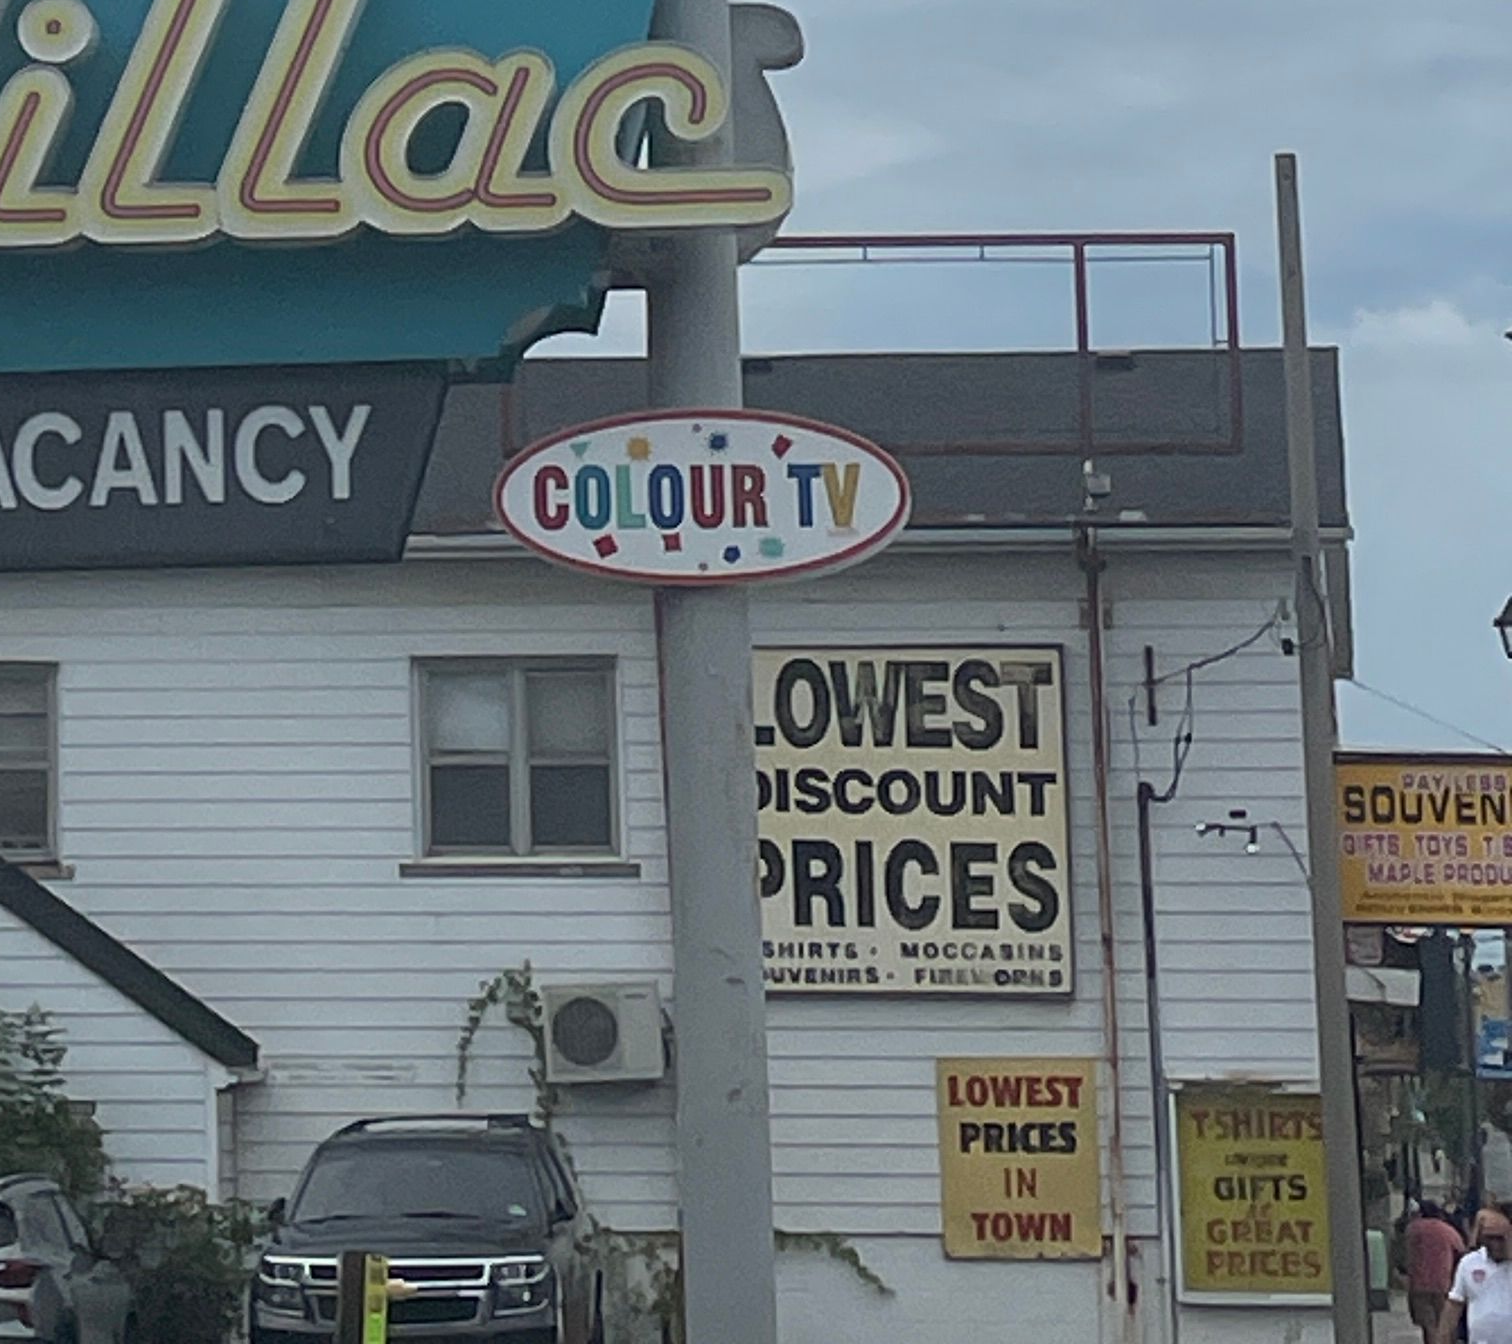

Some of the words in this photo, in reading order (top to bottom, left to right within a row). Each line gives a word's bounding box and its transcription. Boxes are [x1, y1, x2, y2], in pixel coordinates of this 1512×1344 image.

[533, 463, 768, 531] COLOUR
[787, 462, 860, 529] TV
[1343, 785, 1512, 825] SOUVEN
[948, 1075, 1083, 1109] LOWEST
[960, 1122, 1076, 1153] PRICES
[1004, 1167, 1037, 1198] IN
[1214, 1175, 1307, 1201] GIFTS
[971, 1212, 1072, 1242] TOWN
[1207, 1218, 1314, 1245] GREAT
[1206, 1250, 1321, 1279] PRICES
